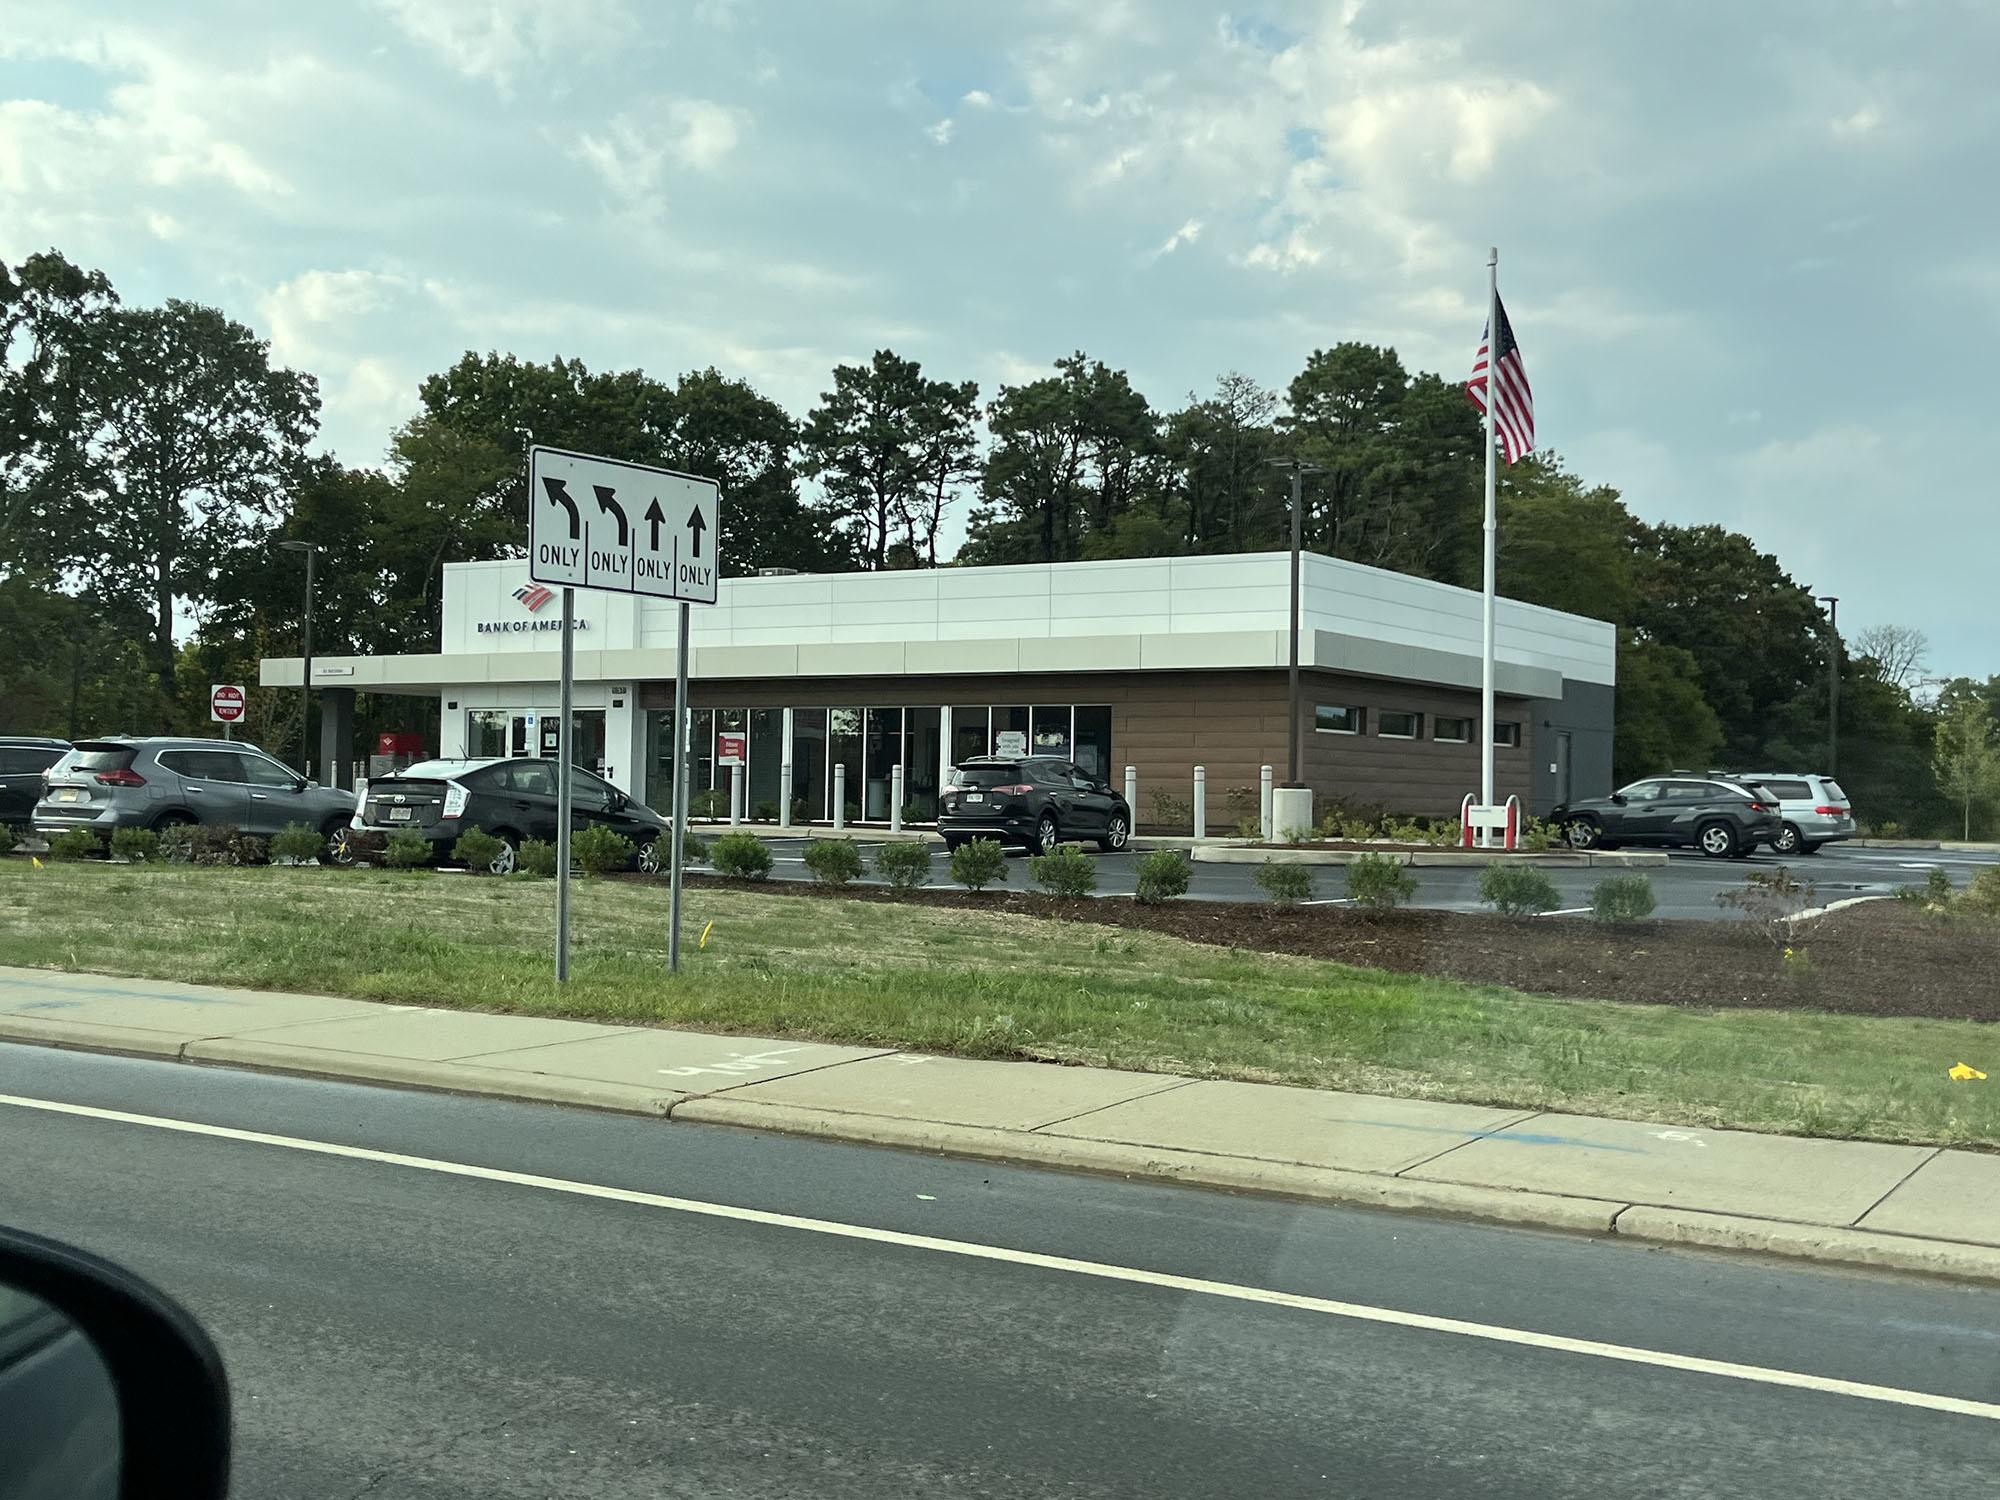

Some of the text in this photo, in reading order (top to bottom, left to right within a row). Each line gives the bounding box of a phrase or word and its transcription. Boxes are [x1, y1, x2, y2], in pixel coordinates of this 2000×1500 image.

[540, 544, 711, 586] ONLY ONLY ONLY ONLY
[477, 622, 511, 633] BANK
[513, 621, 528, 632] OF
